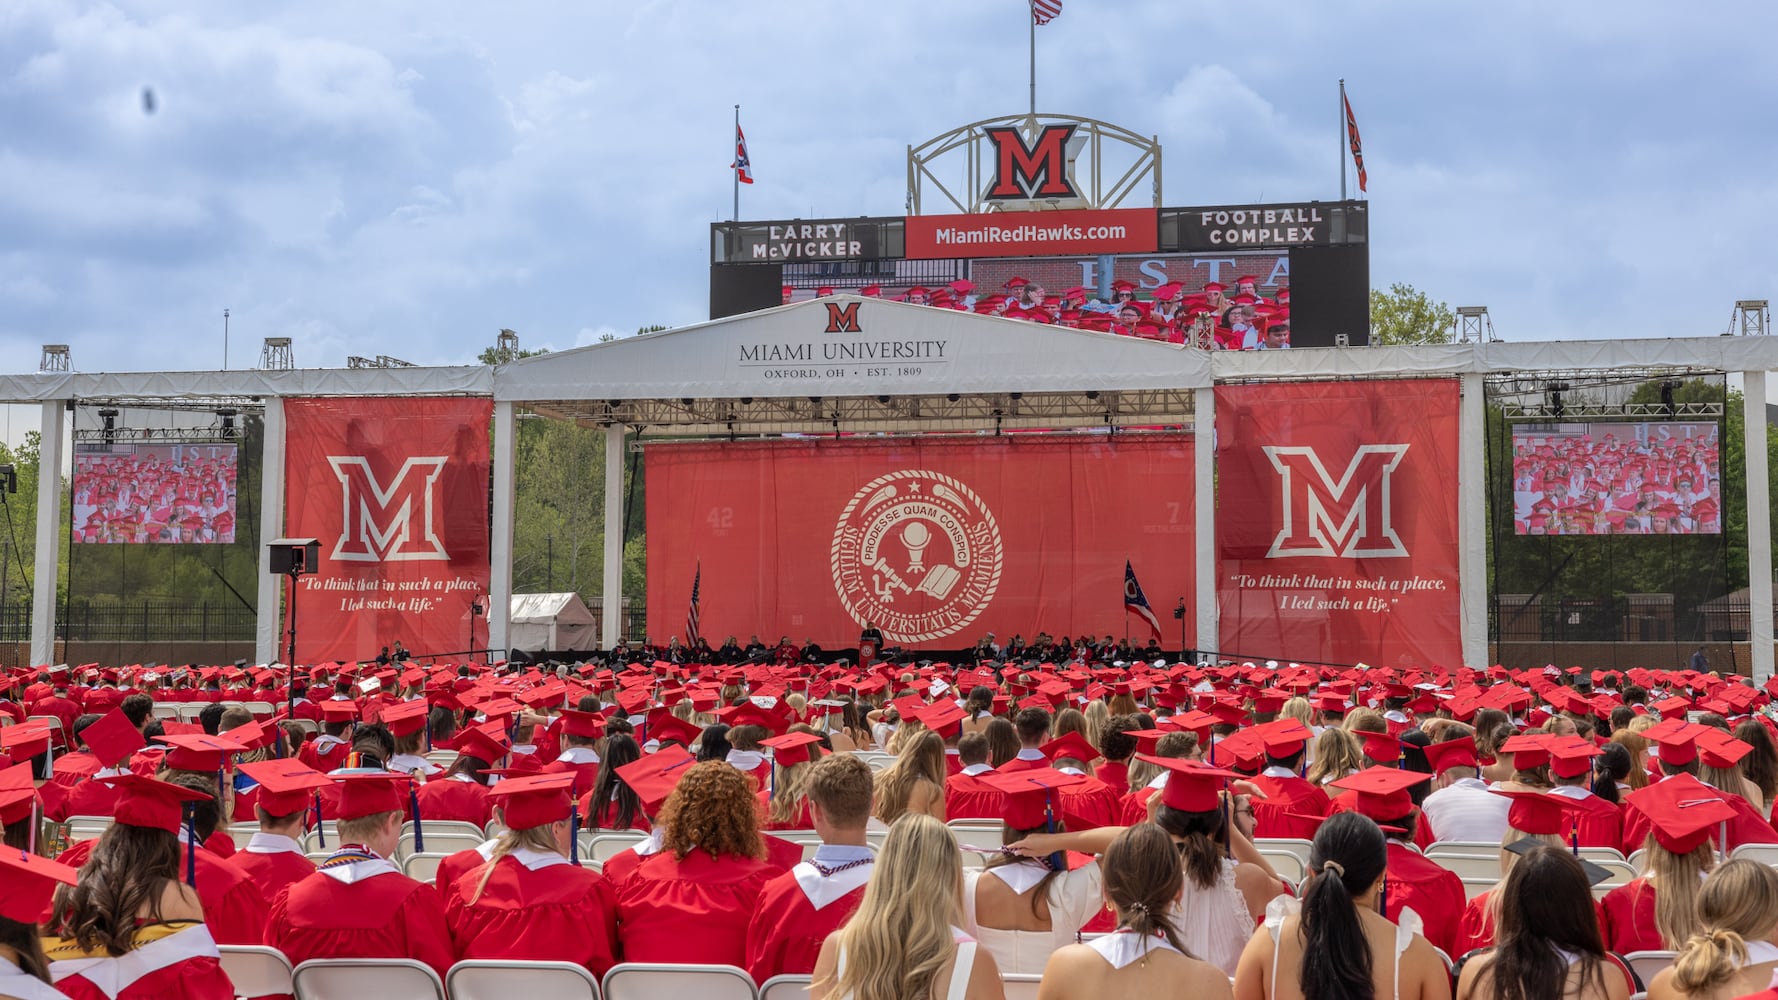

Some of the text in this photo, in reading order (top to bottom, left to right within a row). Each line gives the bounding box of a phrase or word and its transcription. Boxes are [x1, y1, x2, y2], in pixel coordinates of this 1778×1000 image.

[982, 124, 1080, 201] M
[1202, 208, 1323, 226] FOOTBALL
[770, 224, 845, 240] LARRY
[936, 224, 1126, 245] MiamiRedHawks.com
[1210, 227, 1315, 244] COMPLEX
[753, 241, 862, 258] McVICKER
[824, 302, 862, 333] M
[739, 340, 948, 361] MIAMI UNIVERSITY
[764, 367, 922, 379] OXFORD, OH EST. 1809
[326, 456, 451, 562] M
[1261, 444, 1411, 558] M
[865, 505, 967, 563] PRODESSE QUAM CONSPICI
[298, 577, 321, 590] “To
[324, 577, 354, 591] think
[357, 578, 379, 591] that
[382, 579, 395, 591] in
[398, 577, 430, 591] such
[434, 580, 442, 590] a
[840, 521, 994, 634] SIGILLUM UNIVERSITATIS MIAMIENSIS
[1230, 574, 1446, 594] “To think that in such a place,
[340, 598, 347, 611] I
[366, 597, 396, 610] such
[397, 601, 406, 611] a
[1280, 596, 1287, 609] I
[1290, 596, 1313, 609] led
[1317, 596, 1350, 610] such
[1353, 600, 1363, 610] a
